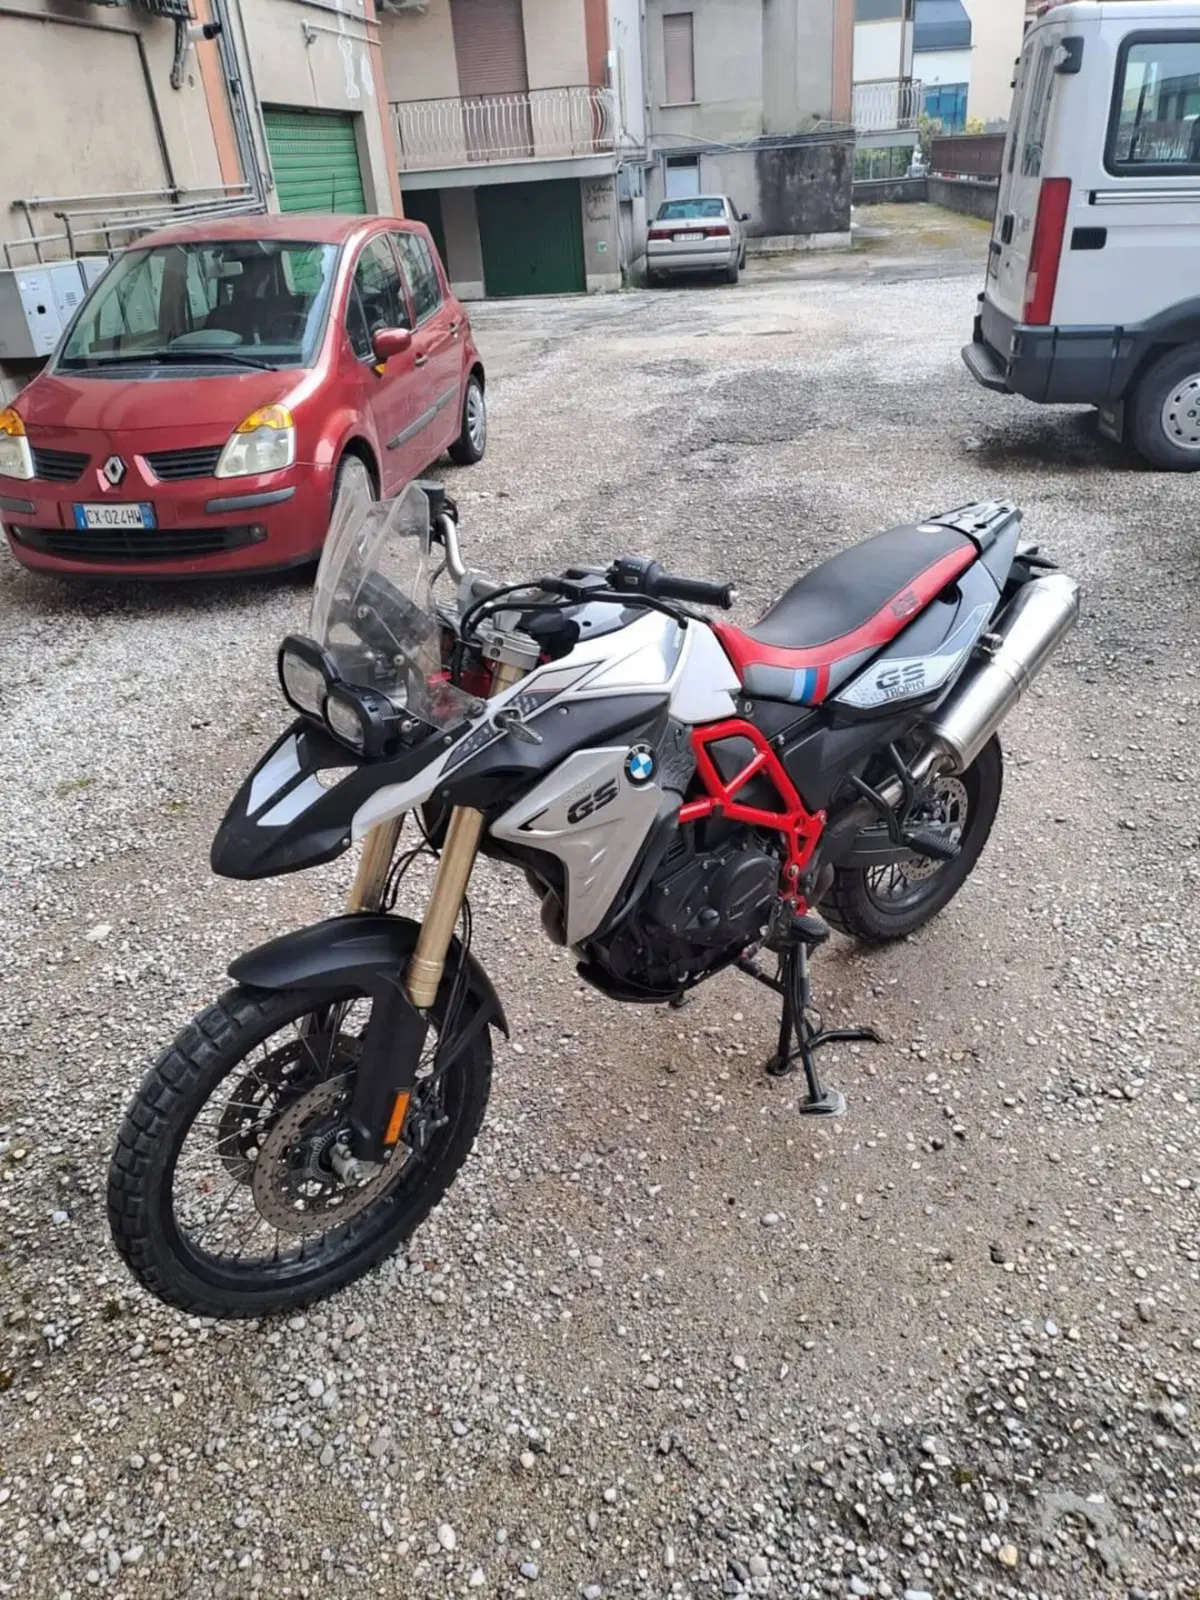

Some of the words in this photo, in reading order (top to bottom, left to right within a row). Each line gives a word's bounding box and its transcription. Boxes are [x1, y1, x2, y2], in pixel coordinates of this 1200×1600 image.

[876, 662, 925, 690] GS
[883, 680, 926, 699] TROPHY
[567, 777, 618, 824] GS
